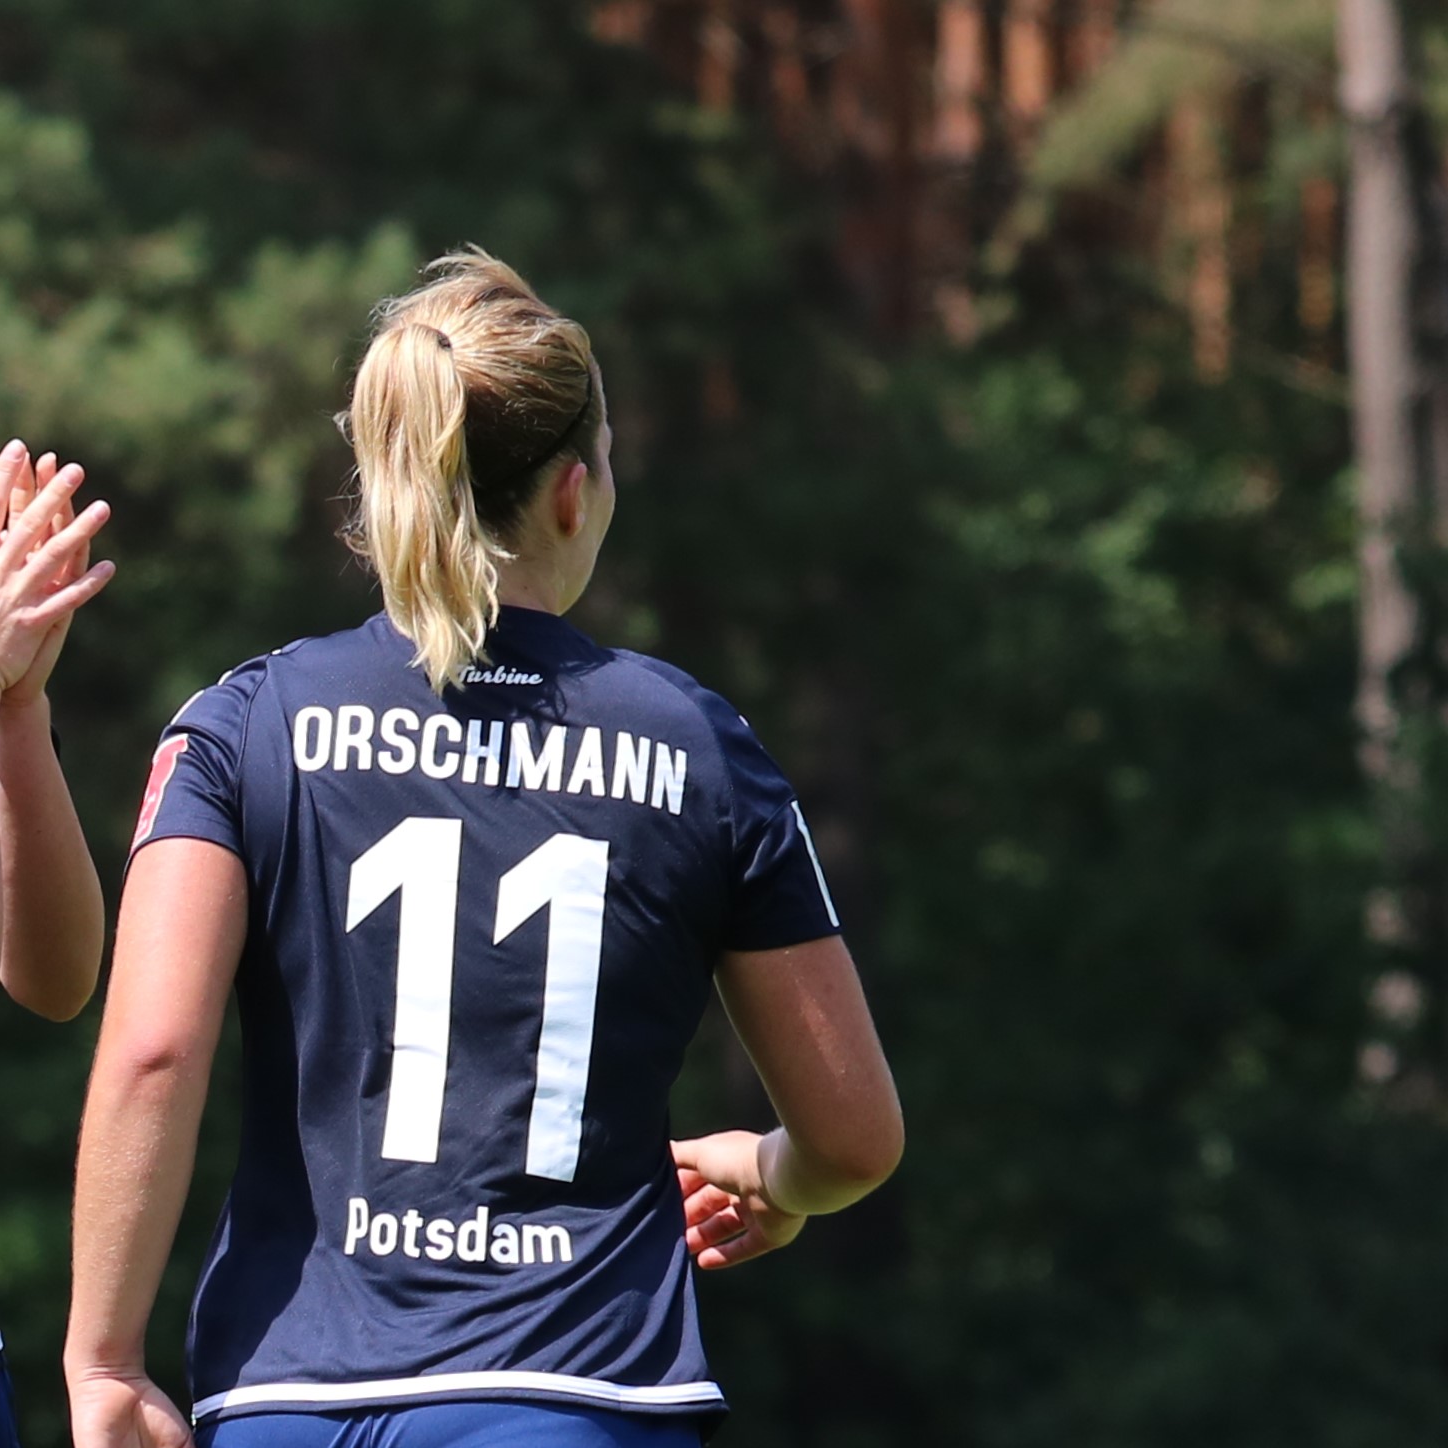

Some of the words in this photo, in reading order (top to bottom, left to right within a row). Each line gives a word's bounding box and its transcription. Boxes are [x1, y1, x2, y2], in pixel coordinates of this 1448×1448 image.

[459, 665, 544, 685] Turbine
[293, 704, 688, 816] ORSCHMANN
[345, 816, 610, 1183] 11
[344, 1197, 573, 1265] Potsdam
